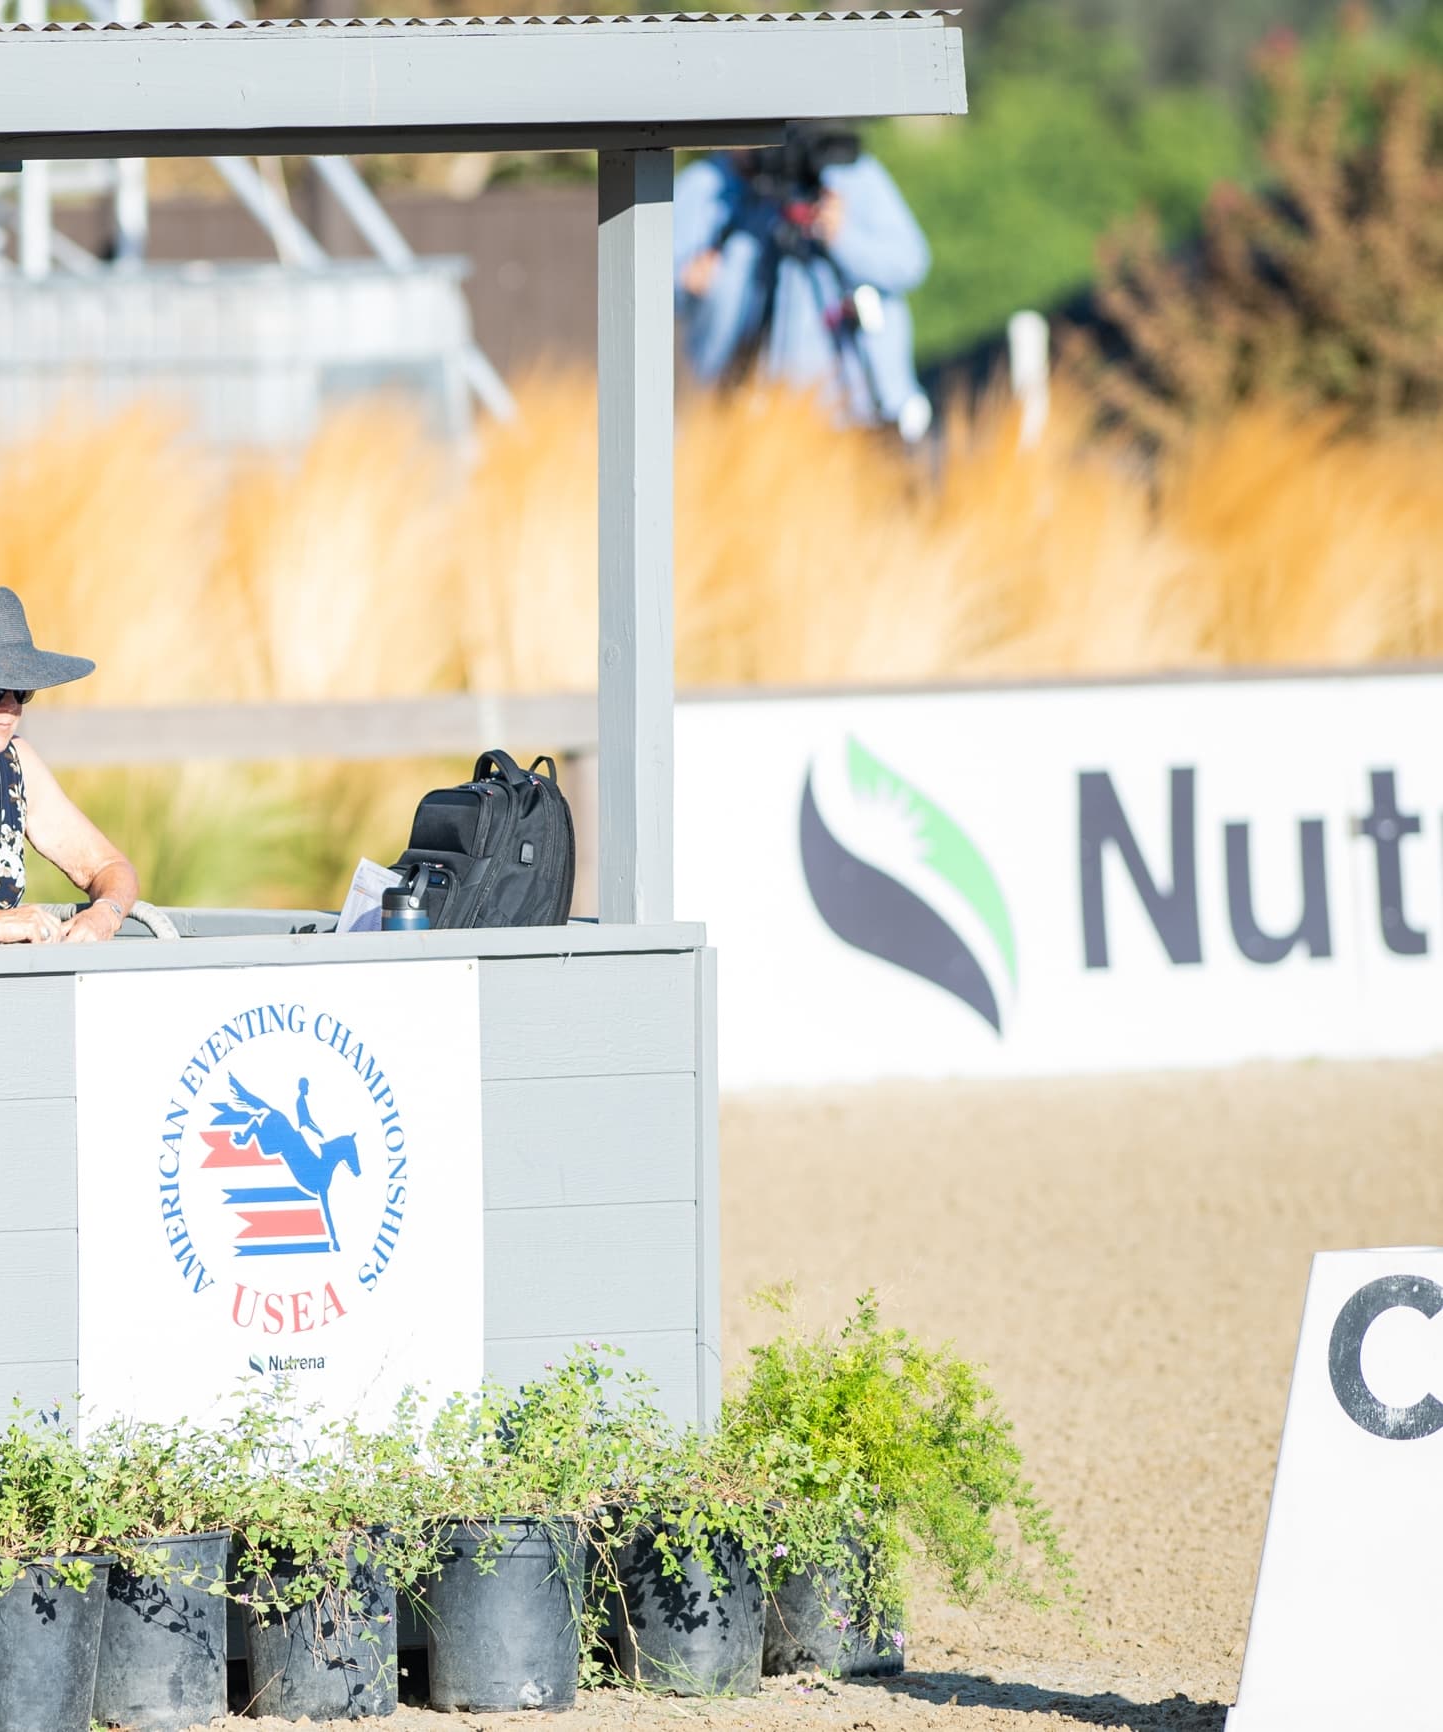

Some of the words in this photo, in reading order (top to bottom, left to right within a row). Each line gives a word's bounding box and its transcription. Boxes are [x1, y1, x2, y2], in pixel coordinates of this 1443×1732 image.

[1077, 767, 1443, 968] Nut
[180, 1003, 306, 1097] EVENTING
[159, 1099, 215, 1293] AMERICAN
[314, 1012, 408, 1292] CHAMPIONSHIPS
[232, 1281, 348, 1334] USEA
[268, 1355, 325, 1371] Nutrena
[1328, 1274, 1443, 1440] C
